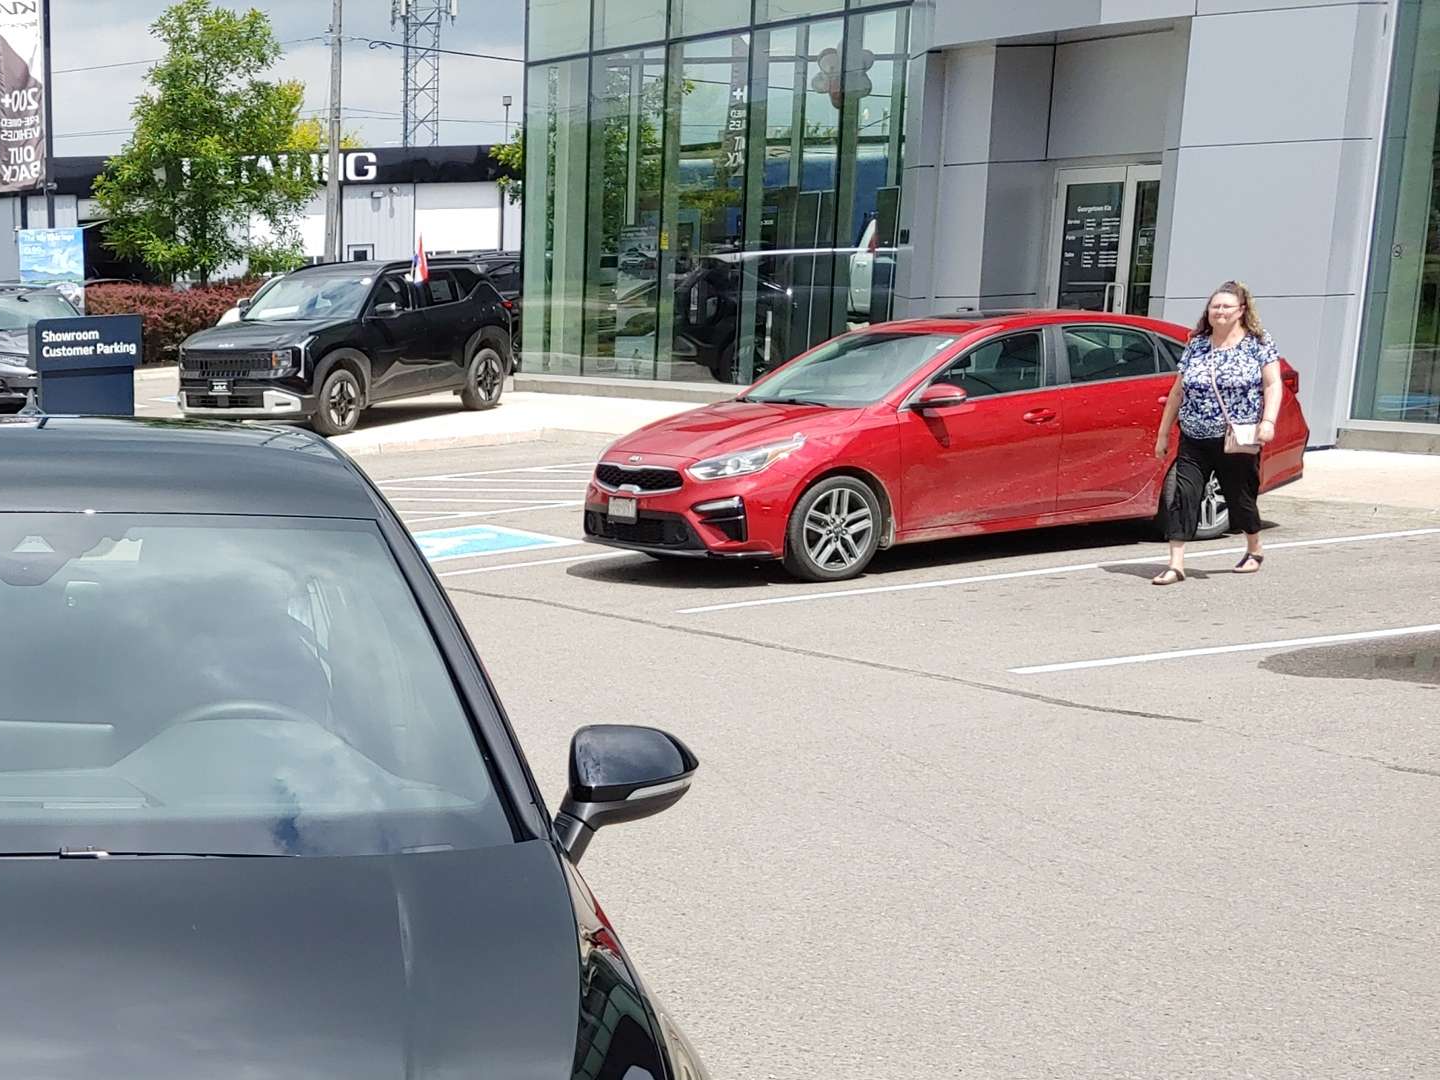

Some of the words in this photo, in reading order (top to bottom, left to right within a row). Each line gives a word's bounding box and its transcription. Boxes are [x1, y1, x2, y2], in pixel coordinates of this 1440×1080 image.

[42, 330, 99, 342] Showroom
[42, 345, 95, 357] Customer
[96, 341, 137, 355] Parking
